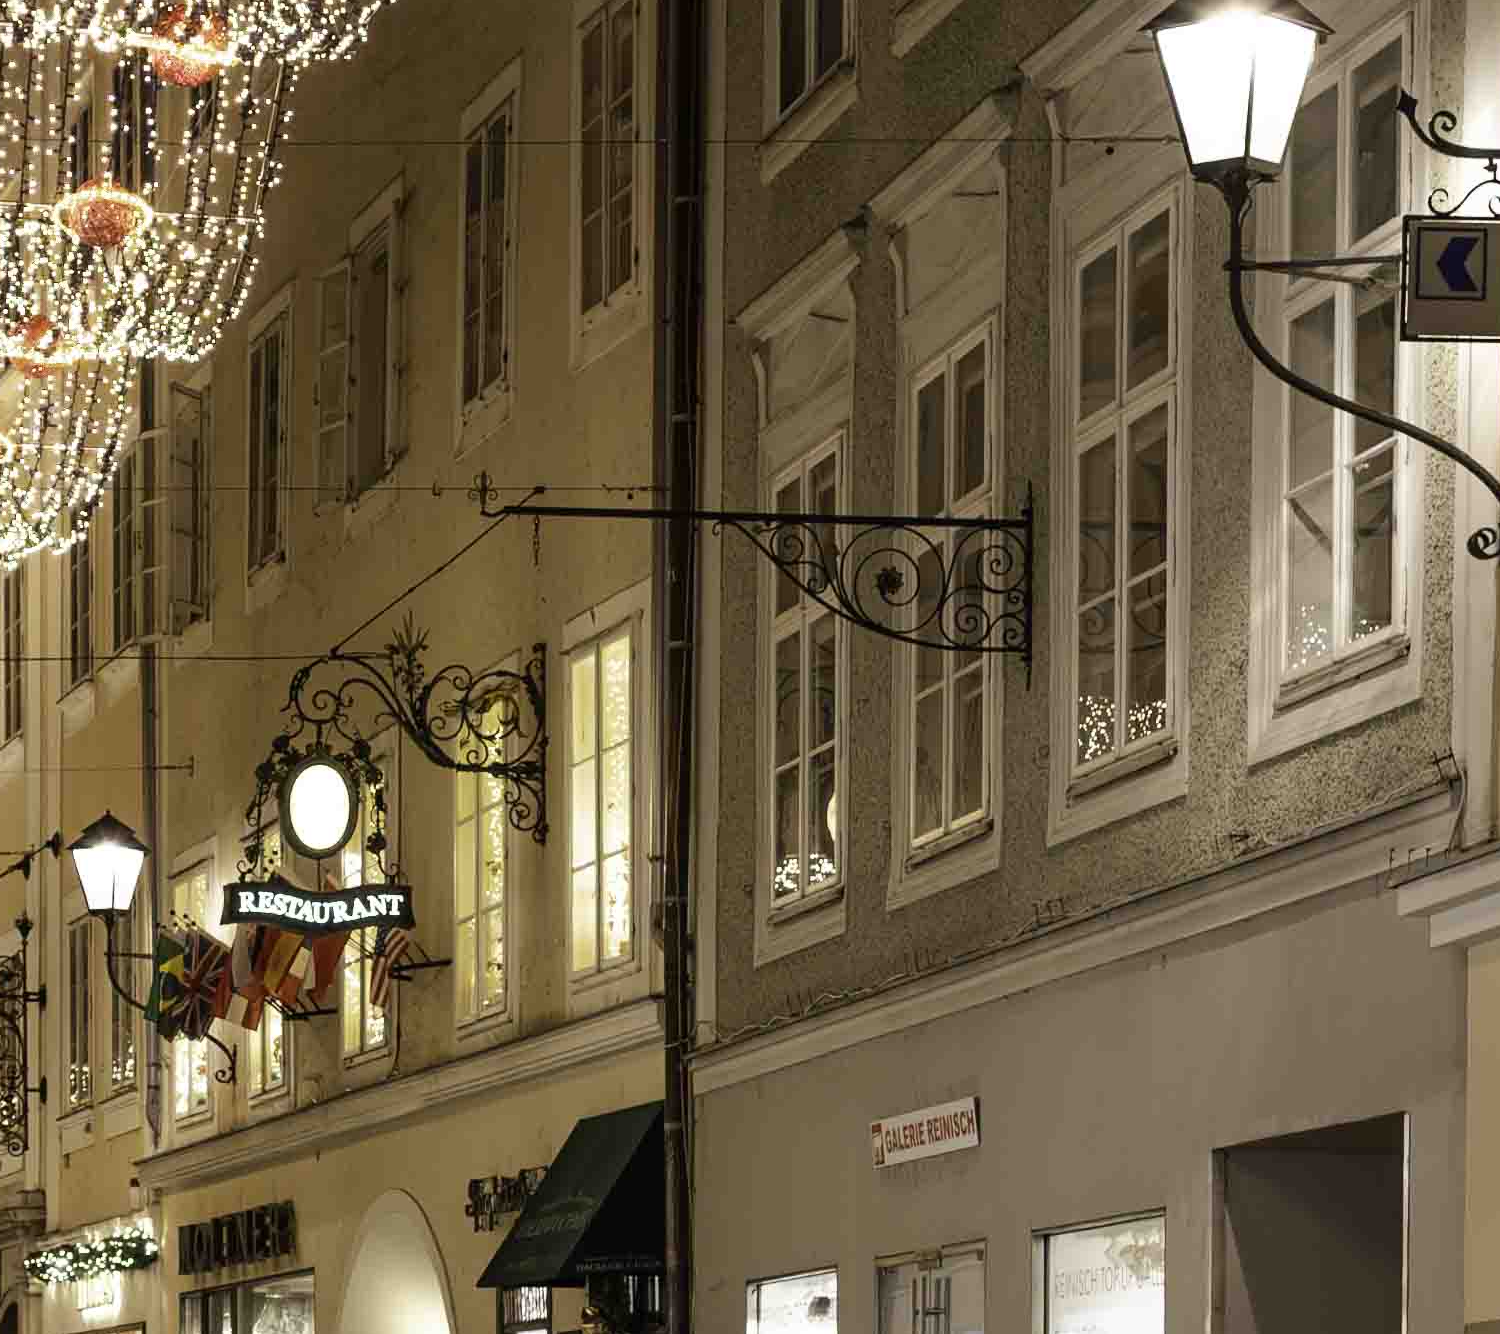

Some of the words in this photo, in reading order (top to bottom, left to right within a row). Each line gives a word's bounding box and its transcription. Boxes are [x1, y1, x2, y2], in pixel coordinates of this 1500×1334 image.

[237, 890, 404, 925] RESTAURANT
[885, 1121, 926, 1154] GALERIE
[927, 1108, 976, 1146] REINISCH
